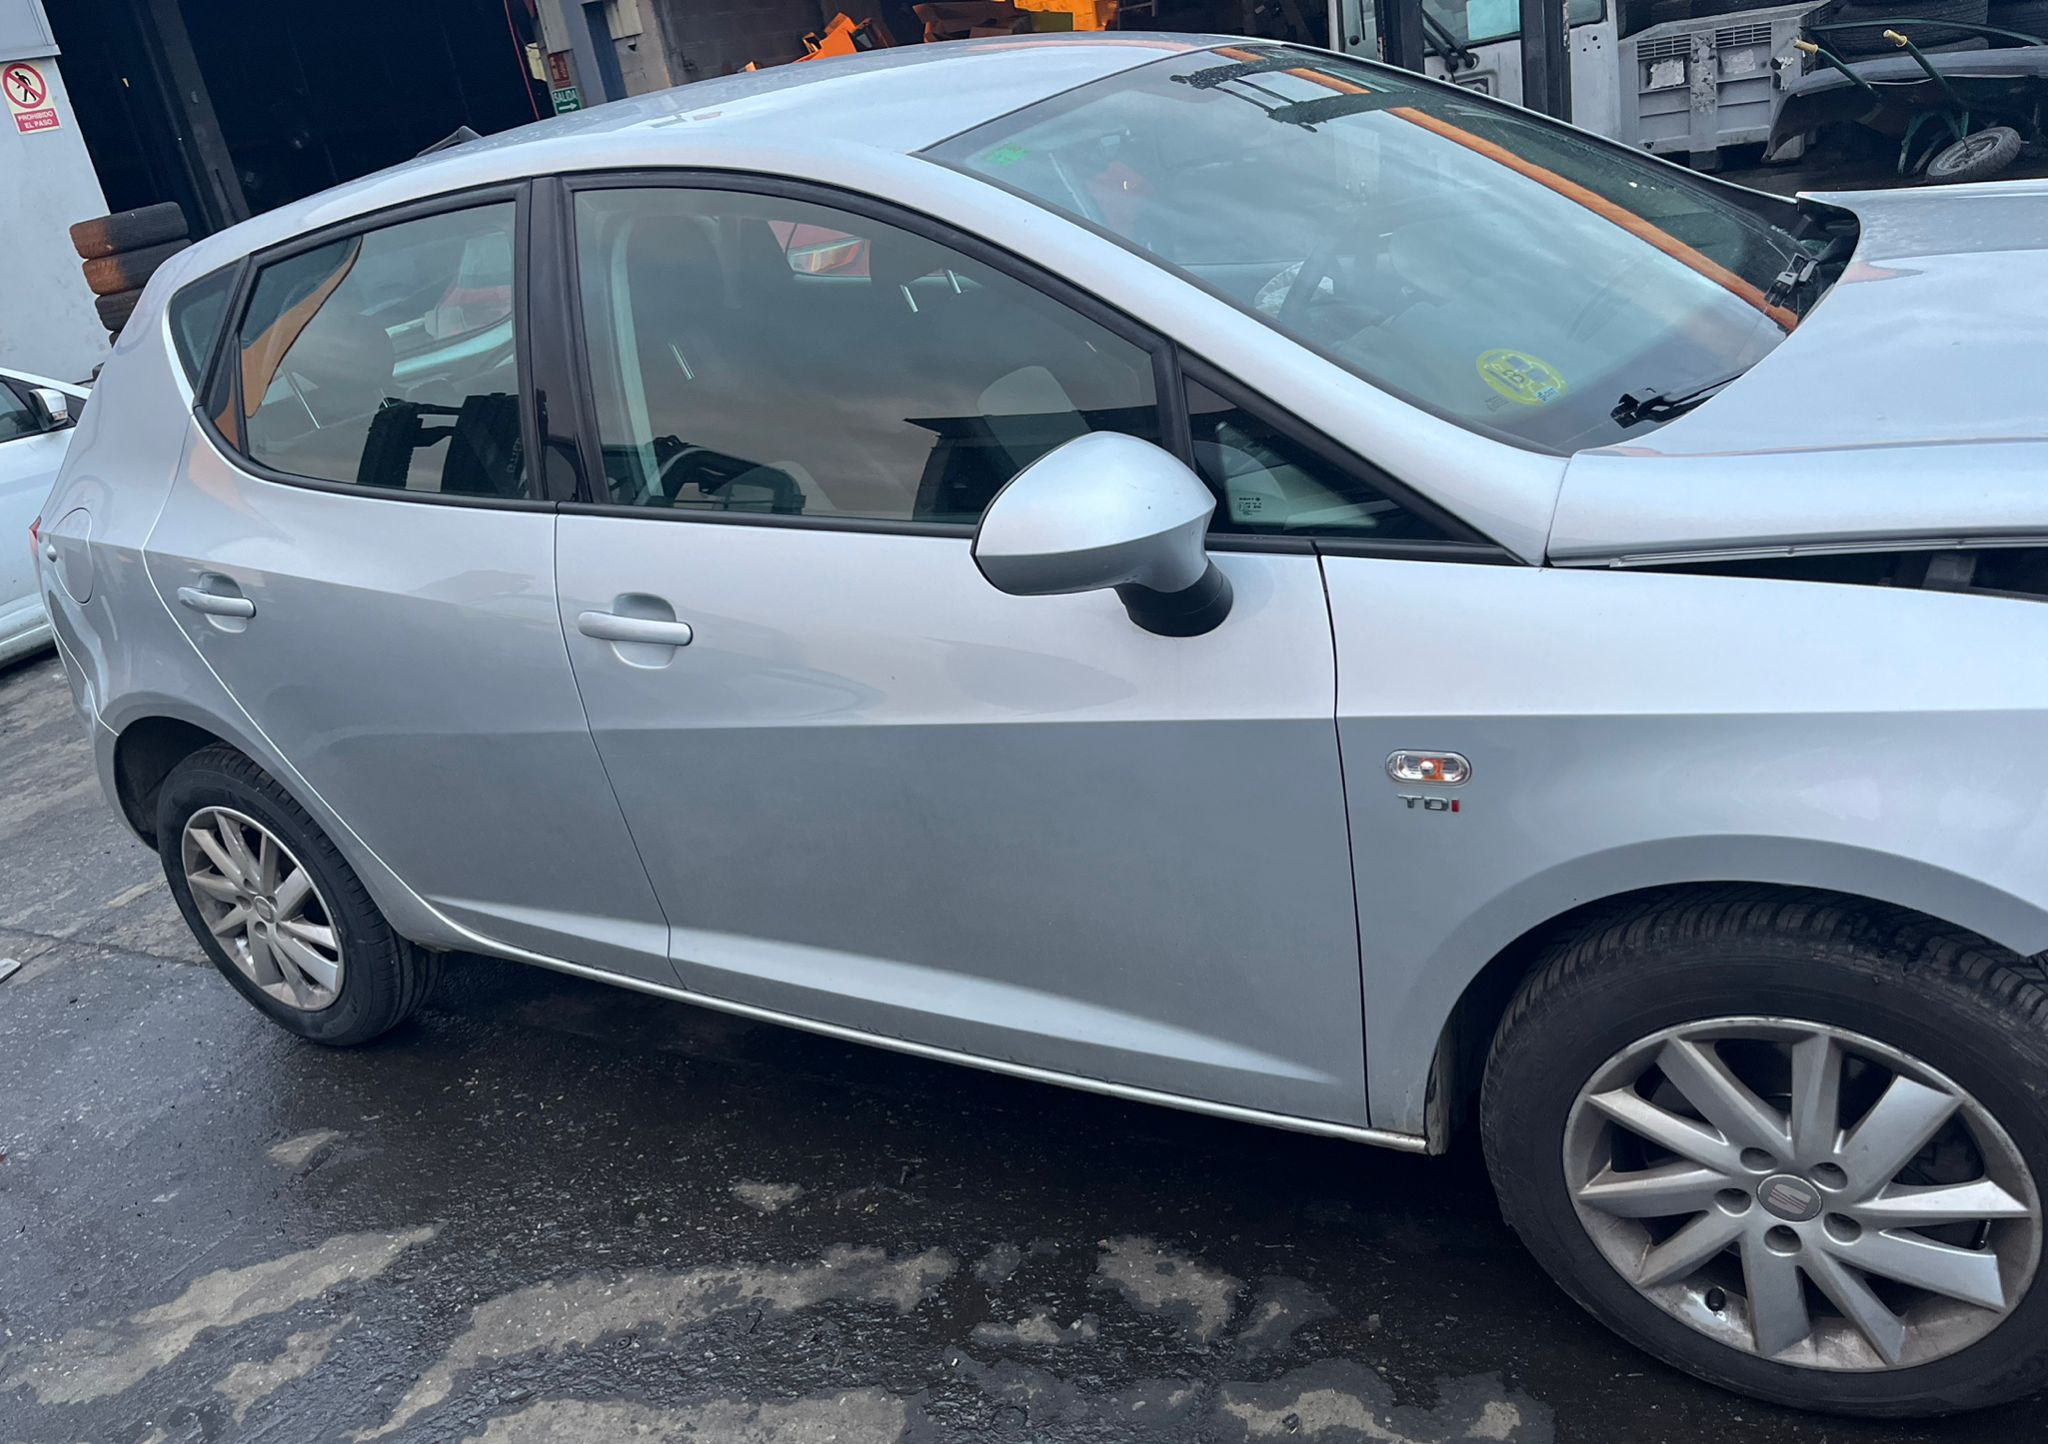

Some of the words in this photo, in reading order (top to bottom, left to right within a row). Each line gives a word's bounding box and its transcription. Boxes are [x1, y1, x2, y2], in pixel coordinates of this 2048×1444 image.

[553, 89, 577, 103] SALIDA
[17, 110, 54, 121] PROHIBIDO
[34, 119, 53, 127] PASO
